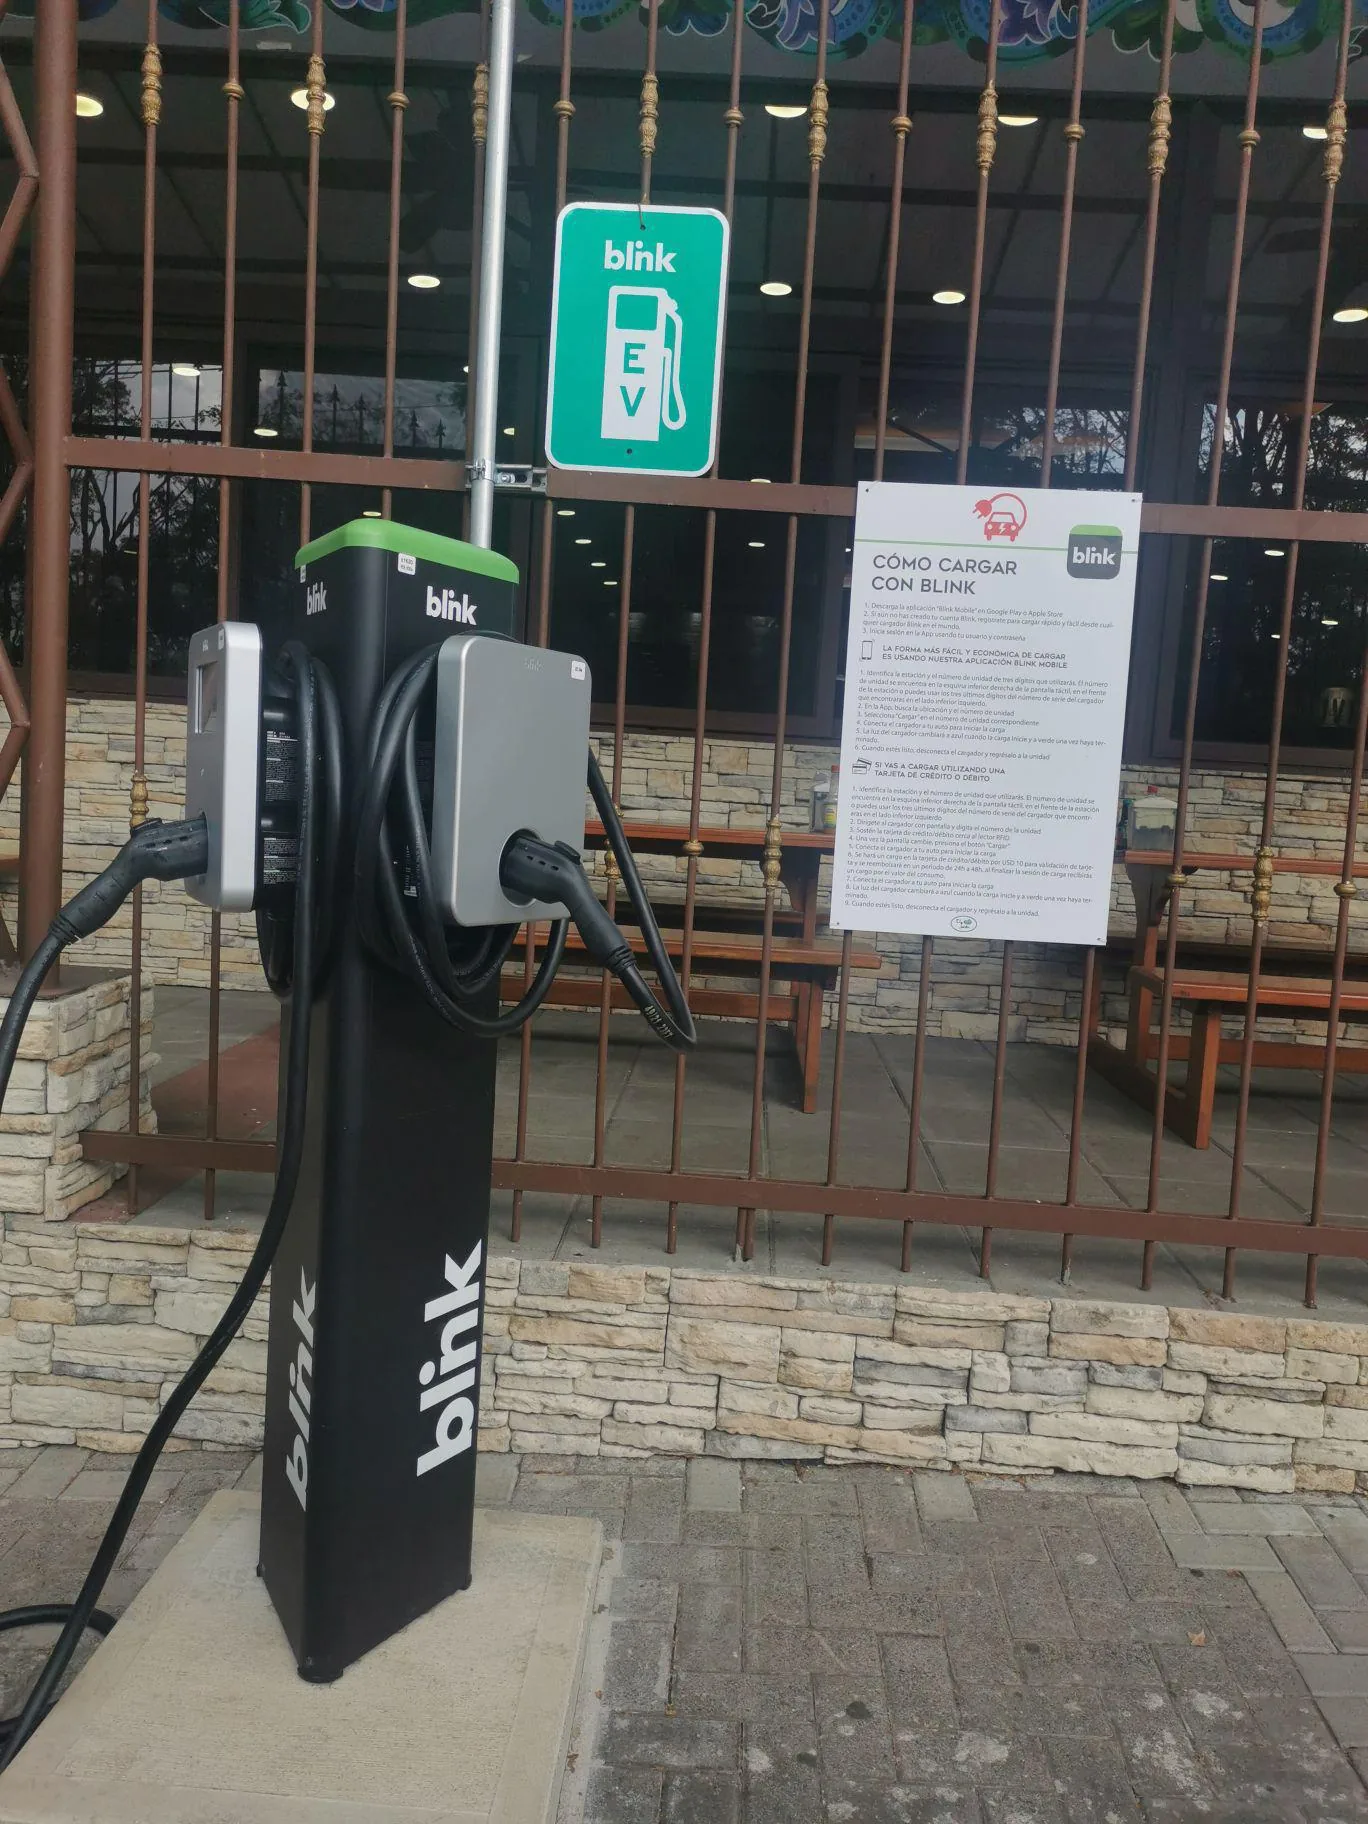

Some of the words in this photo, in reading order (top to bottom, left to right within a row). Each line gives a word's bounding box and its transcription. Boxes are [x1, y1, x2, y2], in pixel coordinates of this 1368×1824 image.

[604, 239, 677, 273] blink
[872, 551, 932, 570] CÓMO
[938, 557, 1017, 574] CARGAR
[1073, 547, 1115, 565] blink
[871, 576, 913, 591] CON
[920, 578, 975, 594] BLINK
[307, 582, 327, 615] blink
[426, 586, 477, 626] blink
[928, 655, 962, 663] NUESTRA
[964, 656, 1012, 665] APLICACIÓN
[874, 769, 904, 777] TARJETA
[941, 765, 986, 773] UTILIZANDO
[417, 1239, 481, 1477] blink
[287, 1265, 316, 1511] blink
